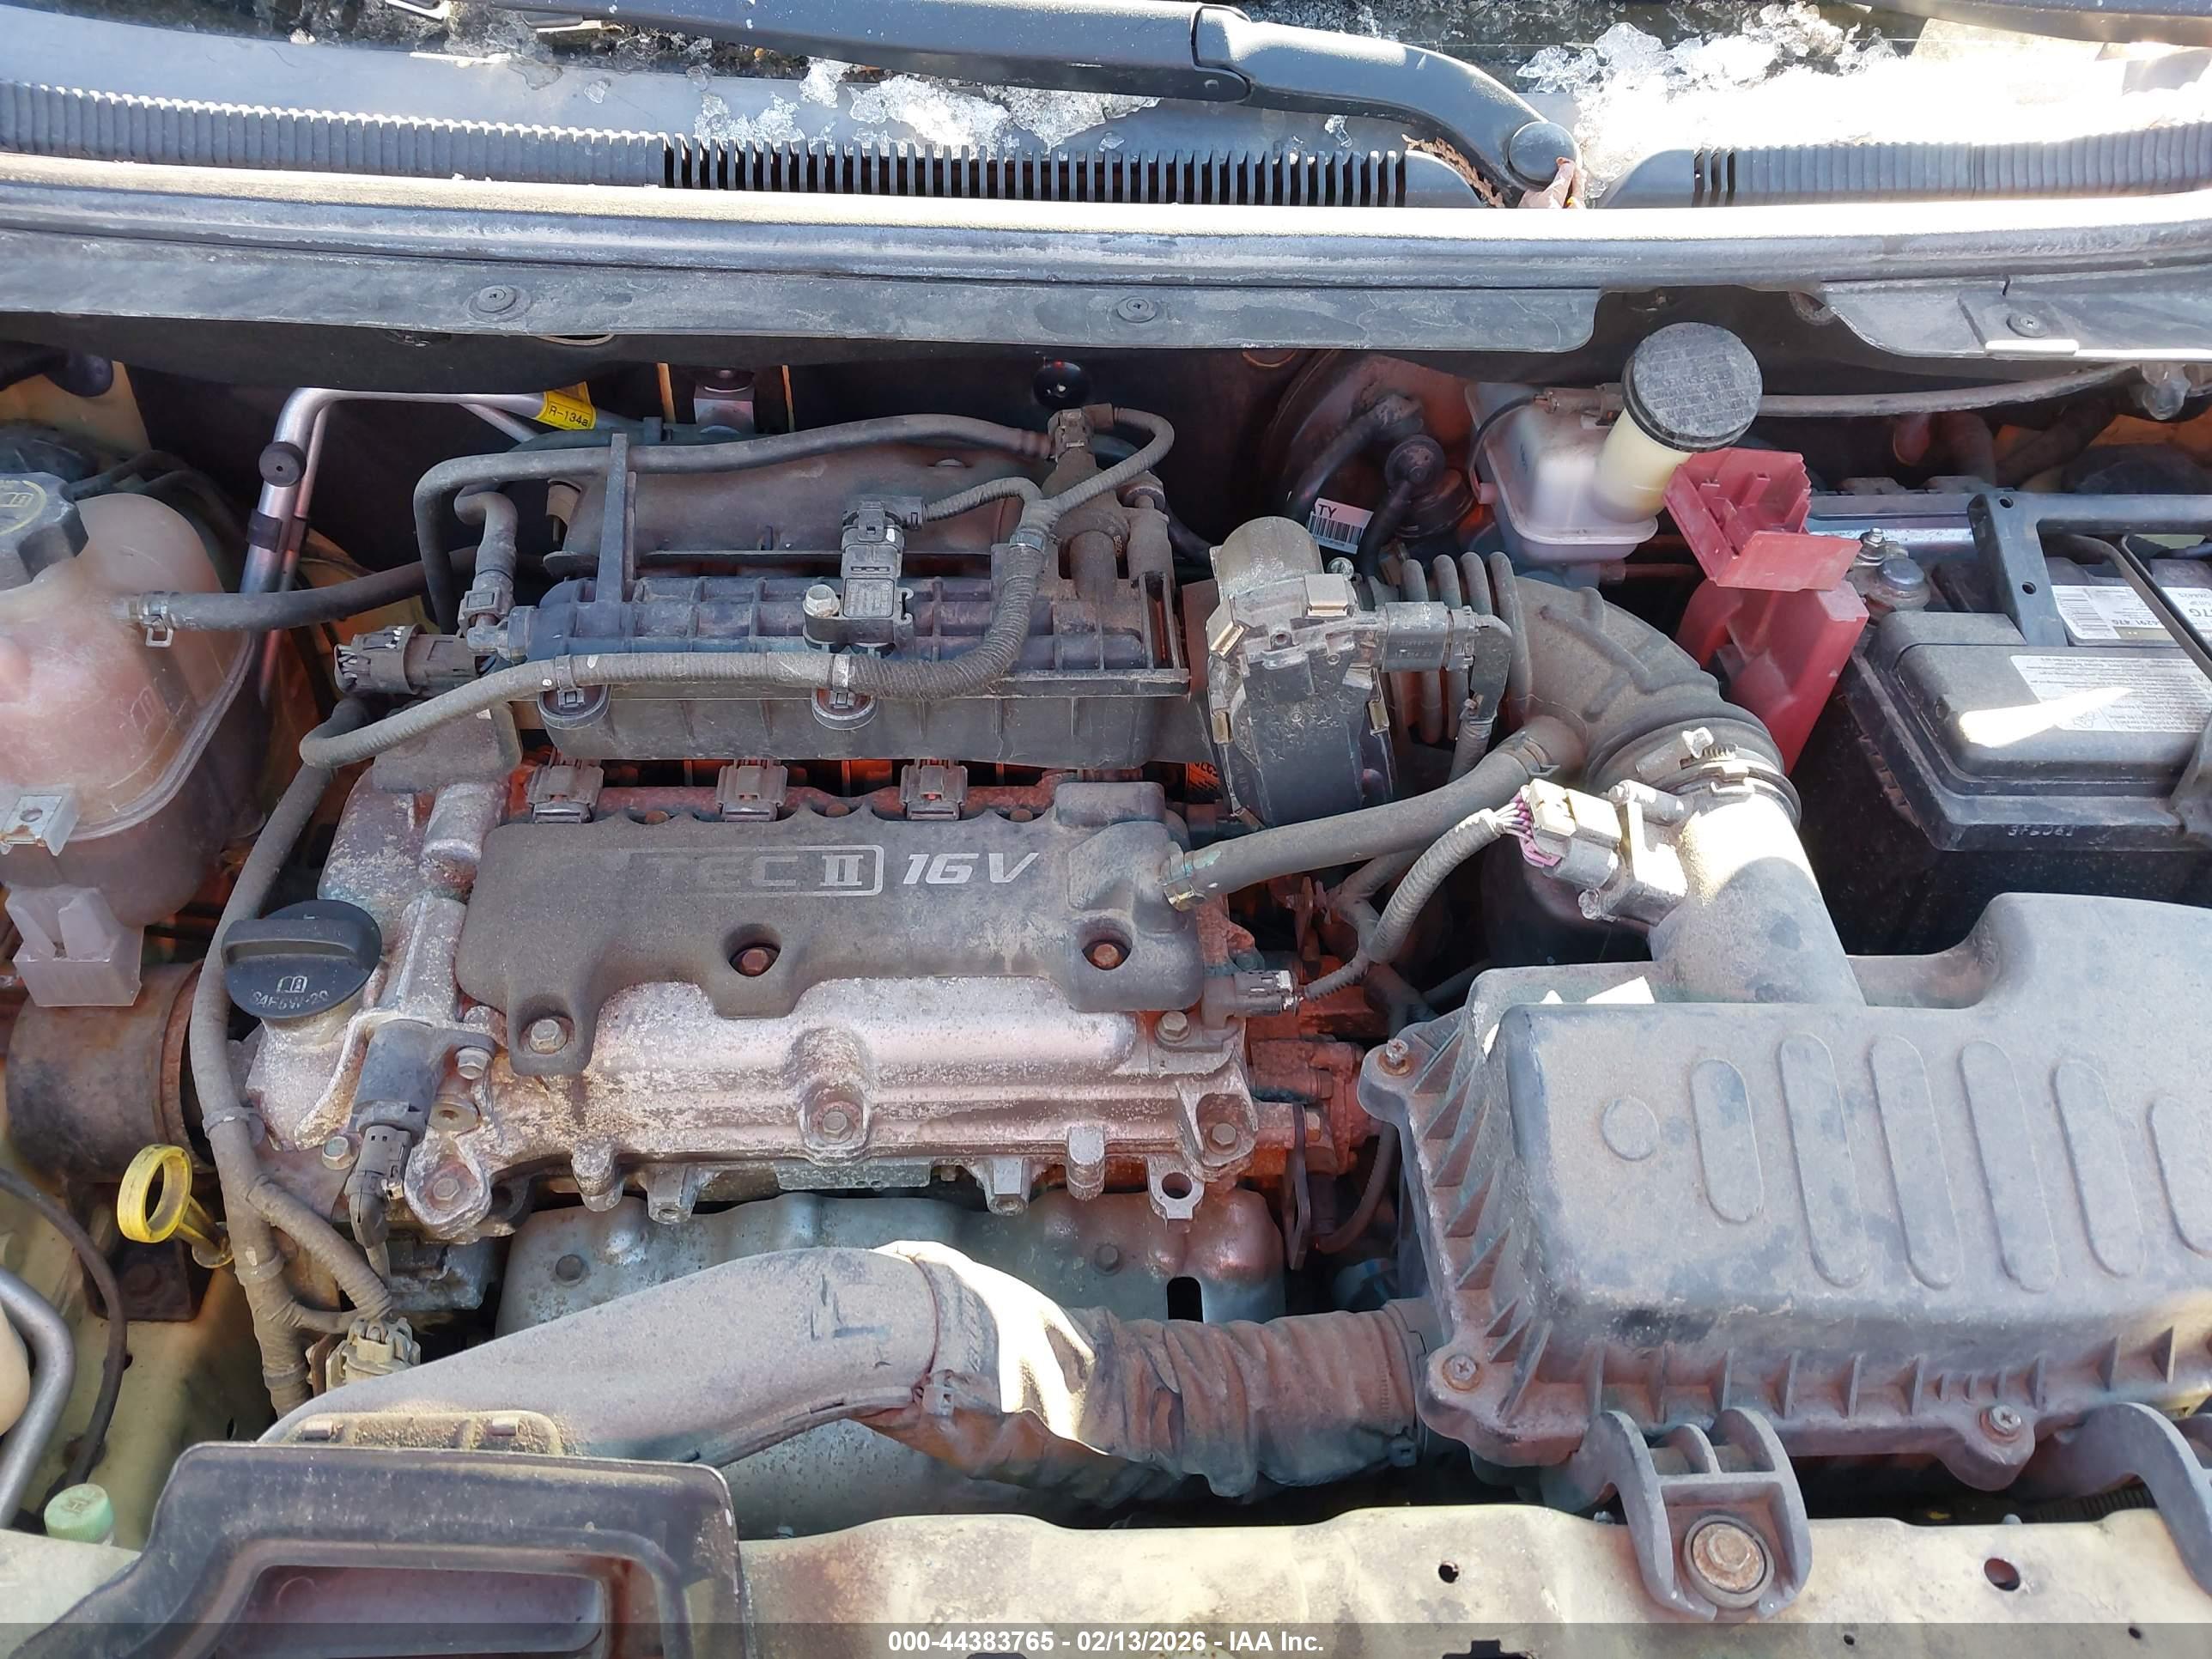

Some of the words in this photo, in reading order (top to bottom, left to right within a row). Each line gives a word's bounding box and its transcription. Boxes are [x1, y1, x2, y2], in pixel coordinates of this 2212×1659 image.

[549, 405, 589, 427] R-134a
[820, 854, 864, 887] II
[902, 852, 1040, 885] 16V
